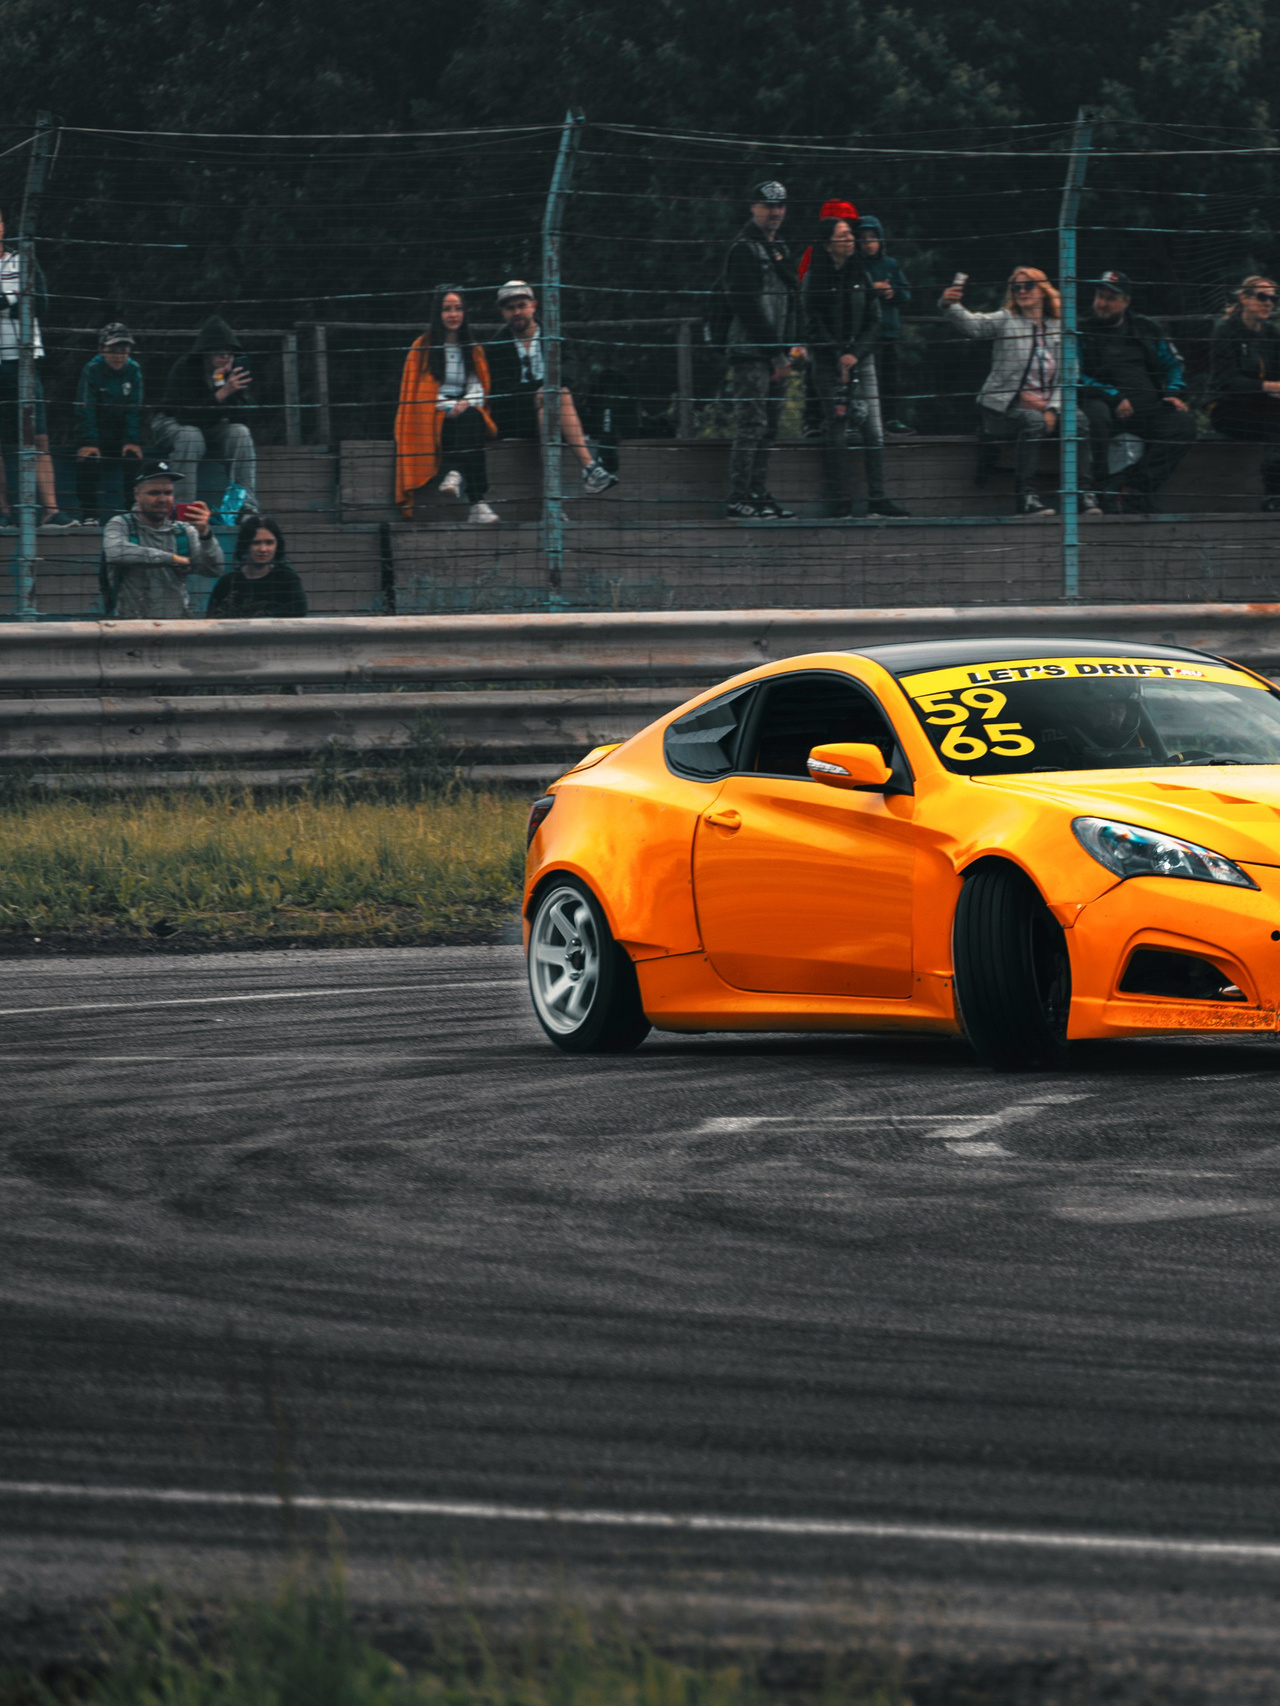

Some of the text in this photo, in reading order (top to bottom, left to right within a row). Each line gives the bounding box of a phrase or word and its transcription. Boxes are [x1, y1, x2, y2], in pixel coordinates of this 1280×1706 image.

[967, 664, 1068, 685] LET'S
[914, 687, 1007, 726] 59
[940, 722, 1035, 761] 65
